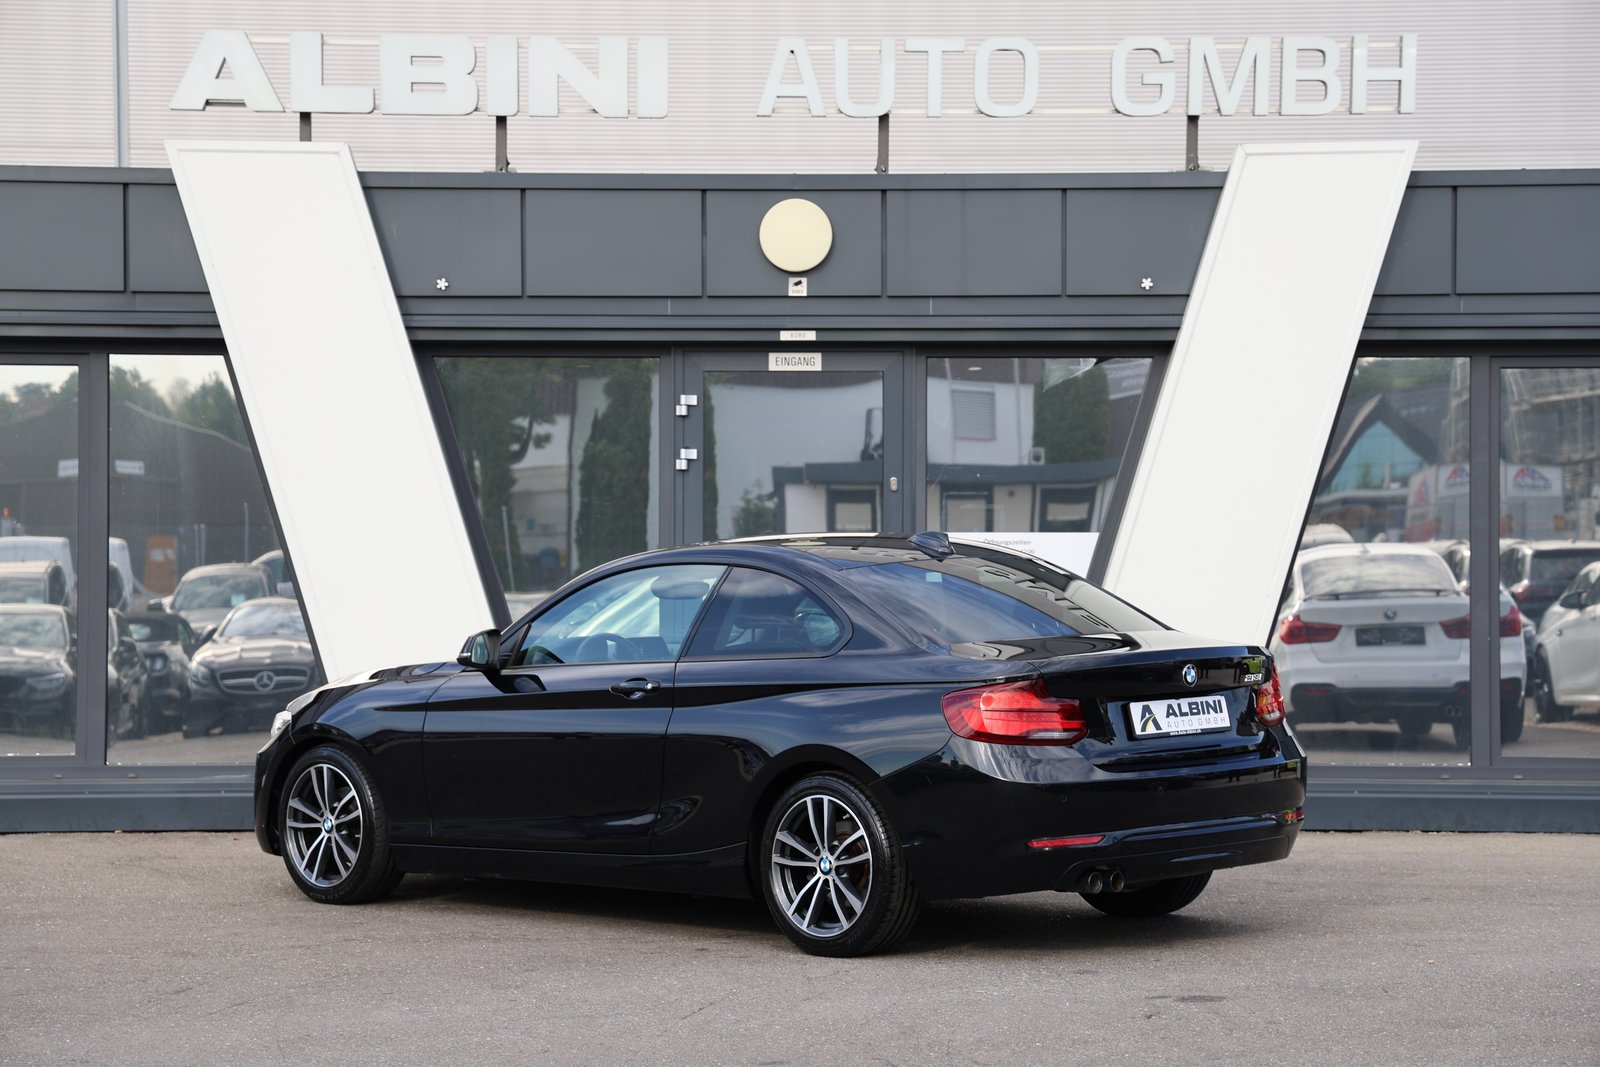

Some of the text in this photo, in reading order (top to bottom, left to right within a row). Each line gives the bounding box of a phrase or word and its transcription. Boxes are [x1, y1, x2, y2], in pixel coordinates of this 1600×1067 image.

[168, 30, 1418, 118] ALBINI AUTO GMBH
[775, 356, 816, 367] EINGANG
[1165, 700, 1223, 718] ALBINI
[1167, 716, 1226, 728] AUTO GMBH
